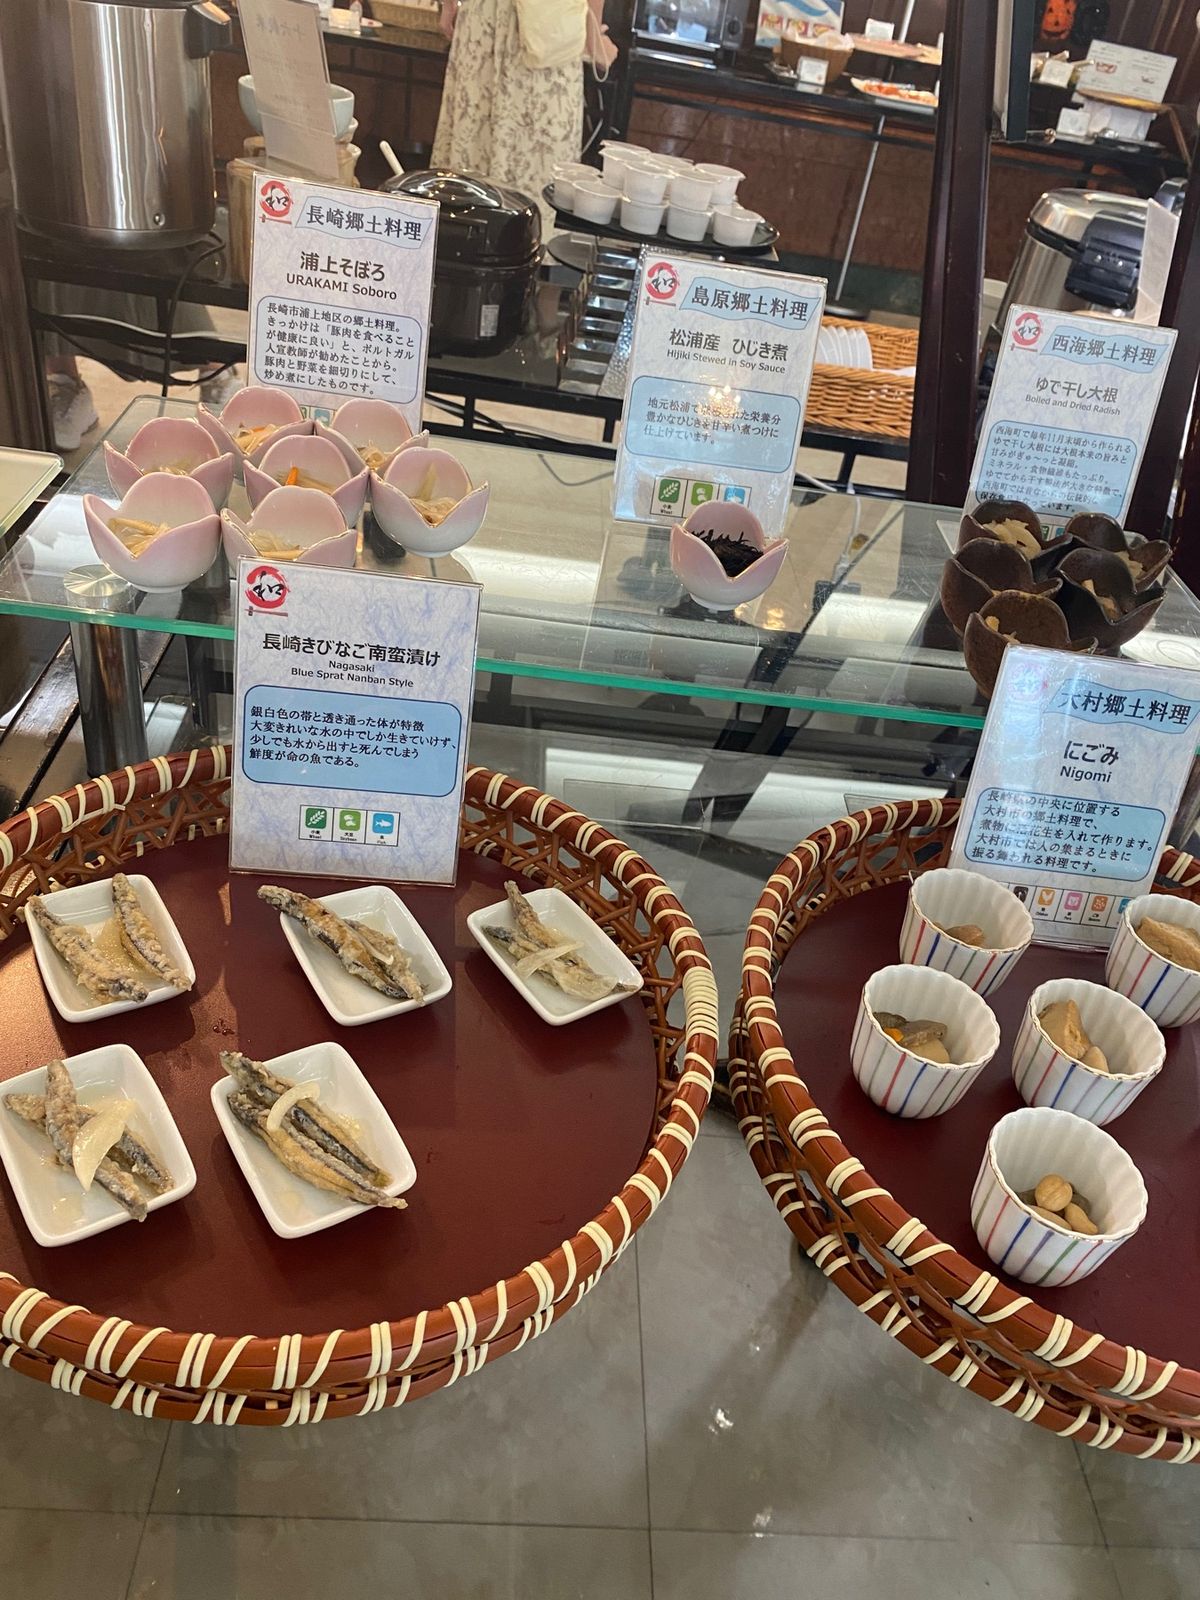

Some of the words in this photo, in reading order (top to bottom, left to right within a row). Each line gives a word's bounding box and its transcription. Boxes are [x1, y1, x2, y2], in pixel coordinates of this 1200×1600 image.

[306, 205, 422, 241] 長崎郷土料理
[300, 251, 386, 282] 浦上そぼろ
[286, 273, 347, 292] URAKAMI
[352, 283, 397, 300] Soboro
[692, 286, 809, 321] 島原郷土料理
[267, 303, 401, 332] 長崎市浦上地区の郷土料理。
[267, 316, 415, 348] きっかけは「豚肉を食べること
[669, 328, 720, 351] 松浦産
[732, 338, 789, 361] ひじき煮
[667, 350, 690, 362] Hijiki
[693, 352, 726, 365] Stewed
[729, 357, 737, 366] in
[740, 358, 756, 372] Soy
[759, 361, 785, 374] Sauce
[1052, 334, 1157, 366] 西海郷土料理
[264, 356, 396, 385] 豚肉と野菜を細切りにして、
[264, 370, 375, 395] 炒め煮にしたものです。
[1036, 377, 1119, 403] ゆで干し大根
[1025, 394, 1050, 406] Boiled
[1052, 398, 1067, 408] and
[1069, 400, 1092, 411] Dried
[1093, 403, 1120, 416] Radish
[644, 425, 715, 444] 仕上げています。
[262, 633, 441, 668] 長崎きびなご南蛮漬け
[291, 667, 314, 679] Blue
[316, 669, 344, 683] Sprat
[347, 673, 386, 685] Nanban
[388, 675, 414, 688] Style
[329, 660, 375, 673] Nagasaki
[250, 706, 425, 733] 銀白色の帯と透き通った体が特徴
[1057, 690, 1192, 726] 大村郷土料理
[249, 734, 420, 759] 少しでも水から出すと死んでしまう
[250, 720, 456, 750] 大変きれいな水の中でしか生きていけず、
[249, 748, 360, 769] 鮮度が命の魚である。
[1063, 740, 1119, 766] にごみ
[1059, 765, 1112, 783] Nigomi
[983, 805, 1098, 830] 大村市の郷土料理で、
[976, 833, 1131, 862] 大村市では人の集まるときに
